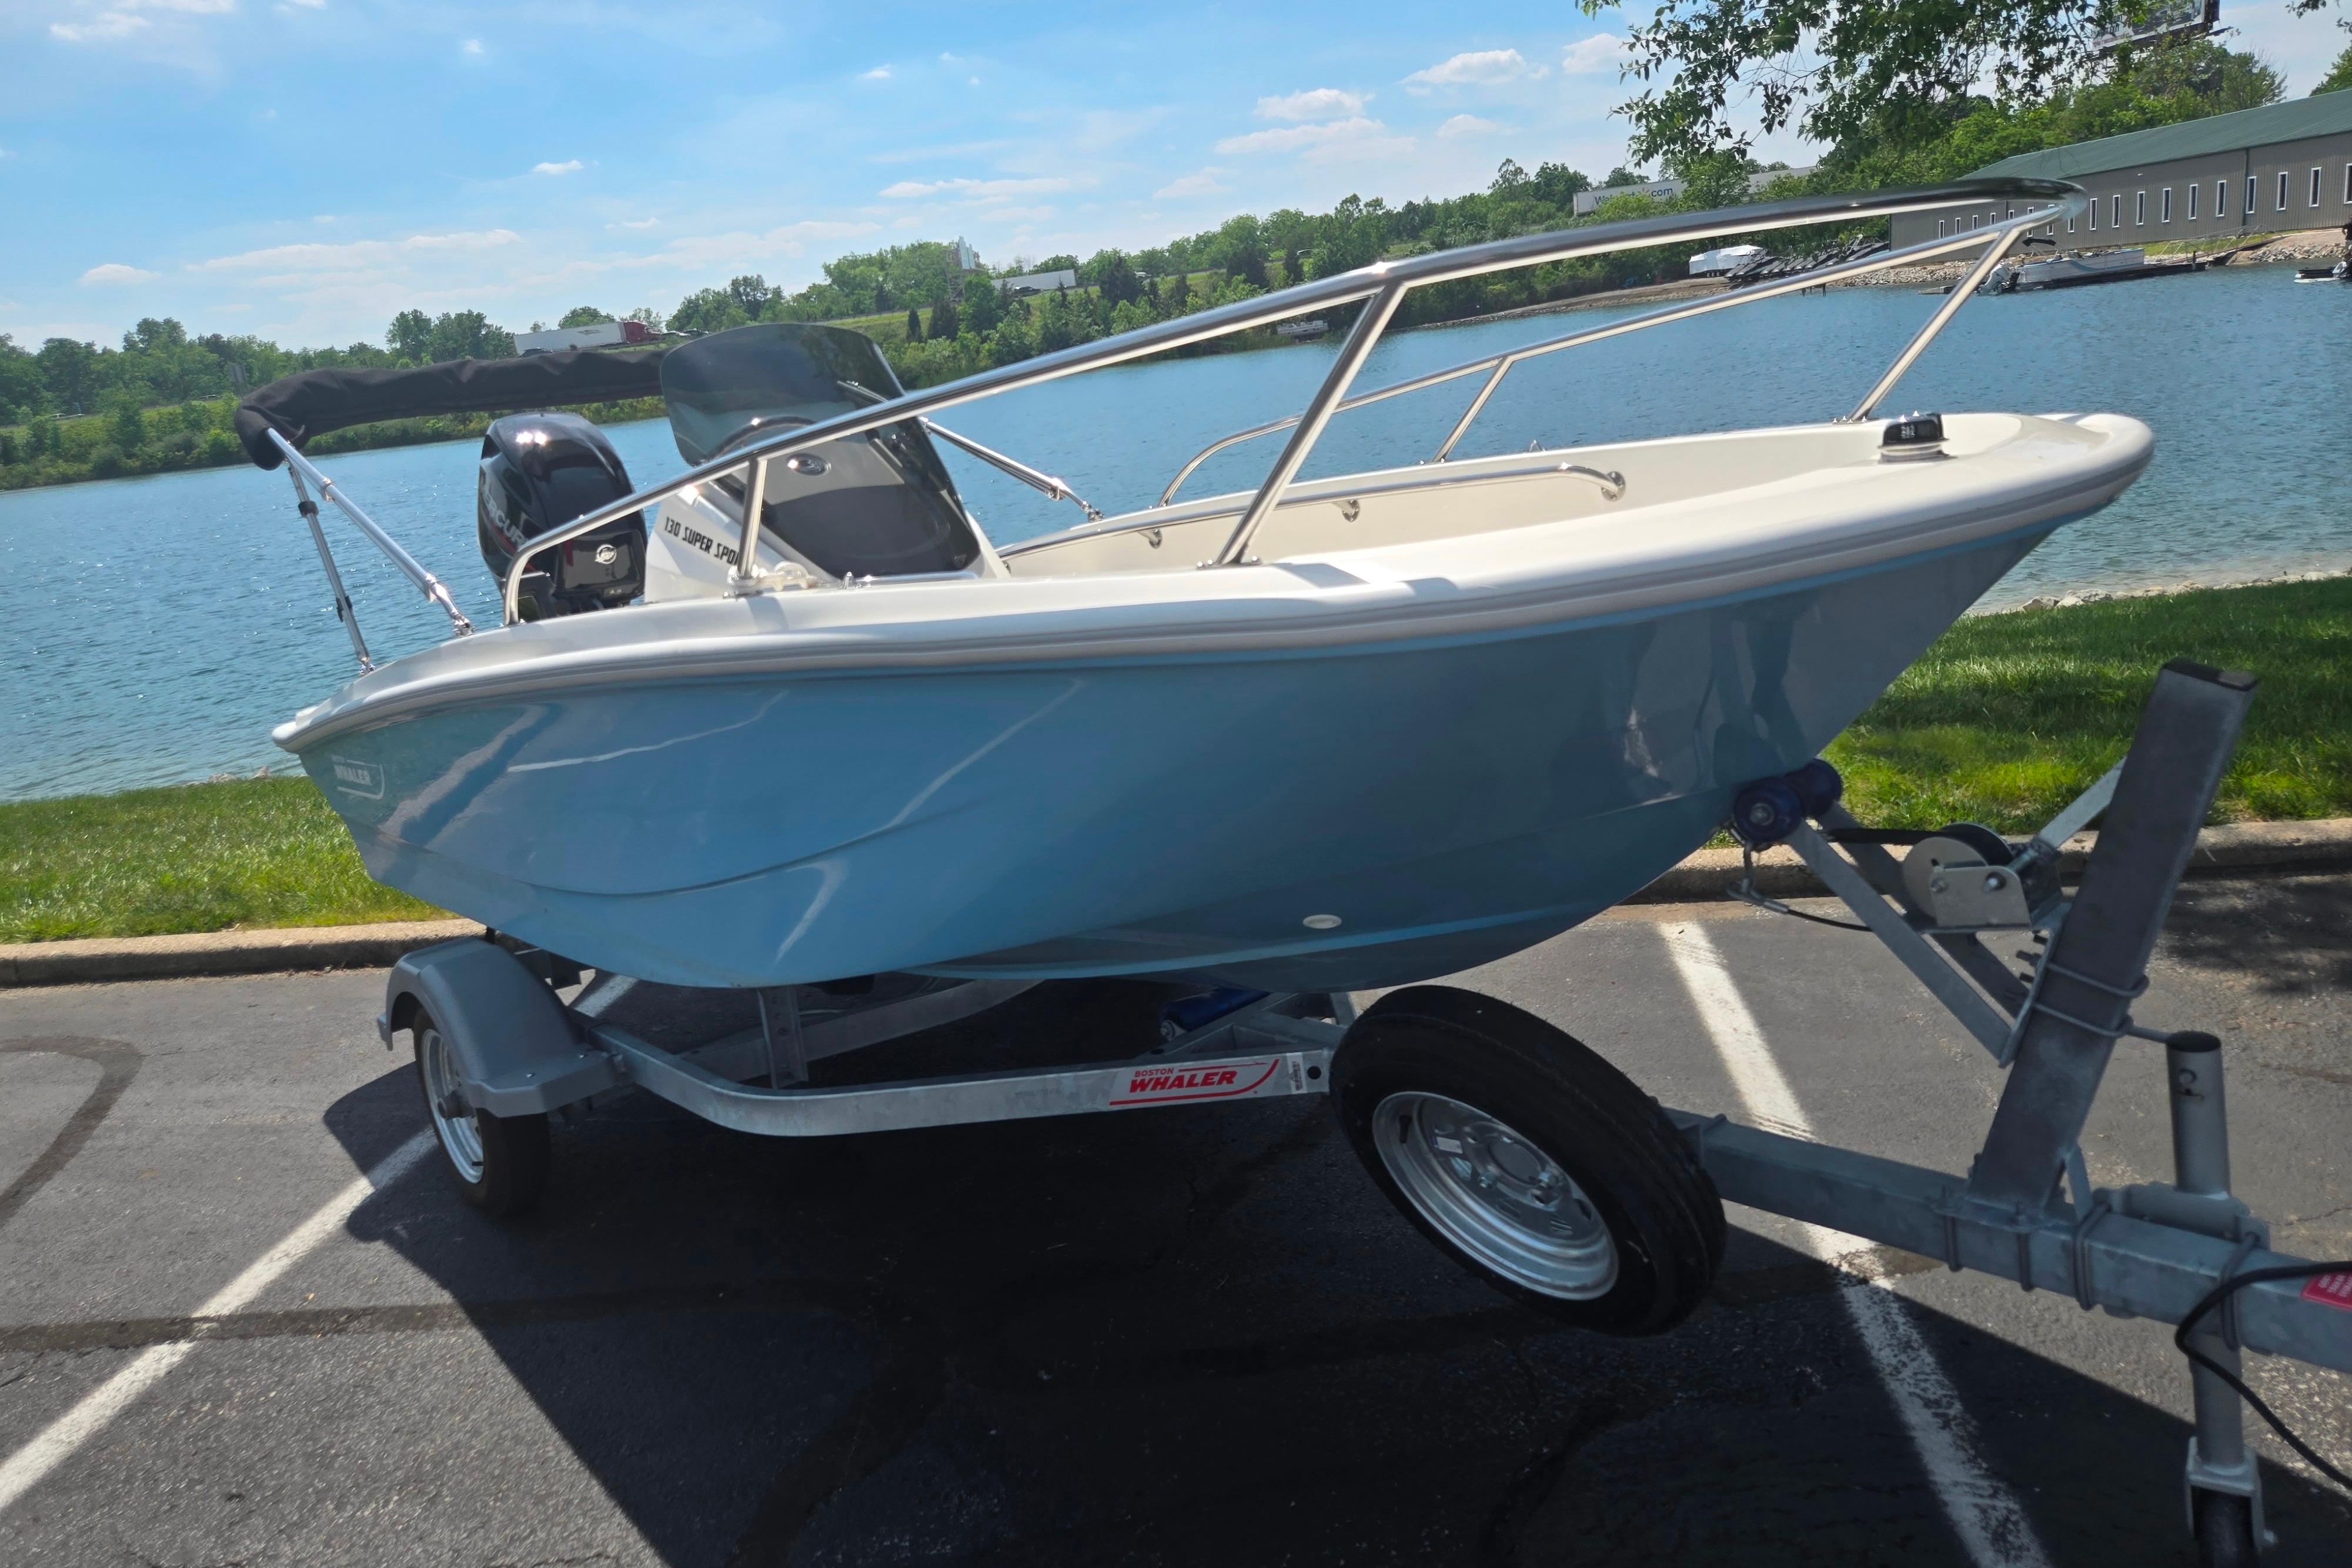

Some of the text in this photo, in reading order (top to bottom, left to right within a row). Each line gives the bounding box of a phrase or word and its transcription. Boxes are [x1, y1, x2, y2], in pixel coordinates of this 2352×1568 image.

[1651, 188, 1673, 198] com
[480, 487, 528, 547] ERCUR
[664, 516, 681, 538] 130
[682, 526, 714, 554] SUPER
[333, 764, 372, 787] WHALER
[1129, 1070, 1238, 1094] WHALER
[1134, 1067, 1174, 1078] BOSTON
